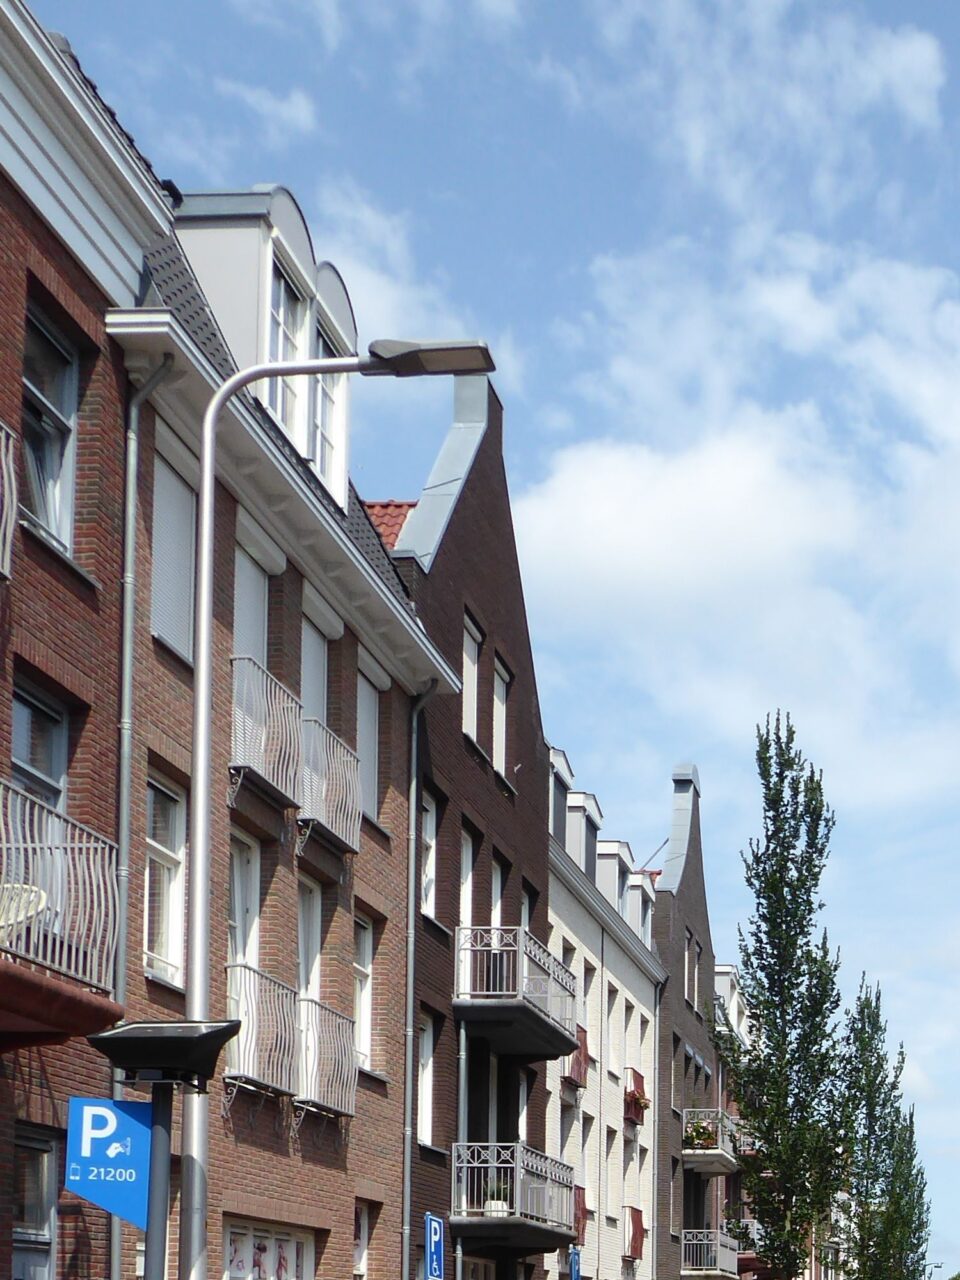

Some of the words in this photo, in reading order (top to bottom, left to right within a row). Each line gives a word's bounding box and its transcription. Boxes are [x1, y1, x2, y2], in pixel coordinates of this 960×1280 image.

[80, 1105, 118, 1158] P
[87, 1167, 136, 1182] 21200
[431, 1220, 440, 1252] P
